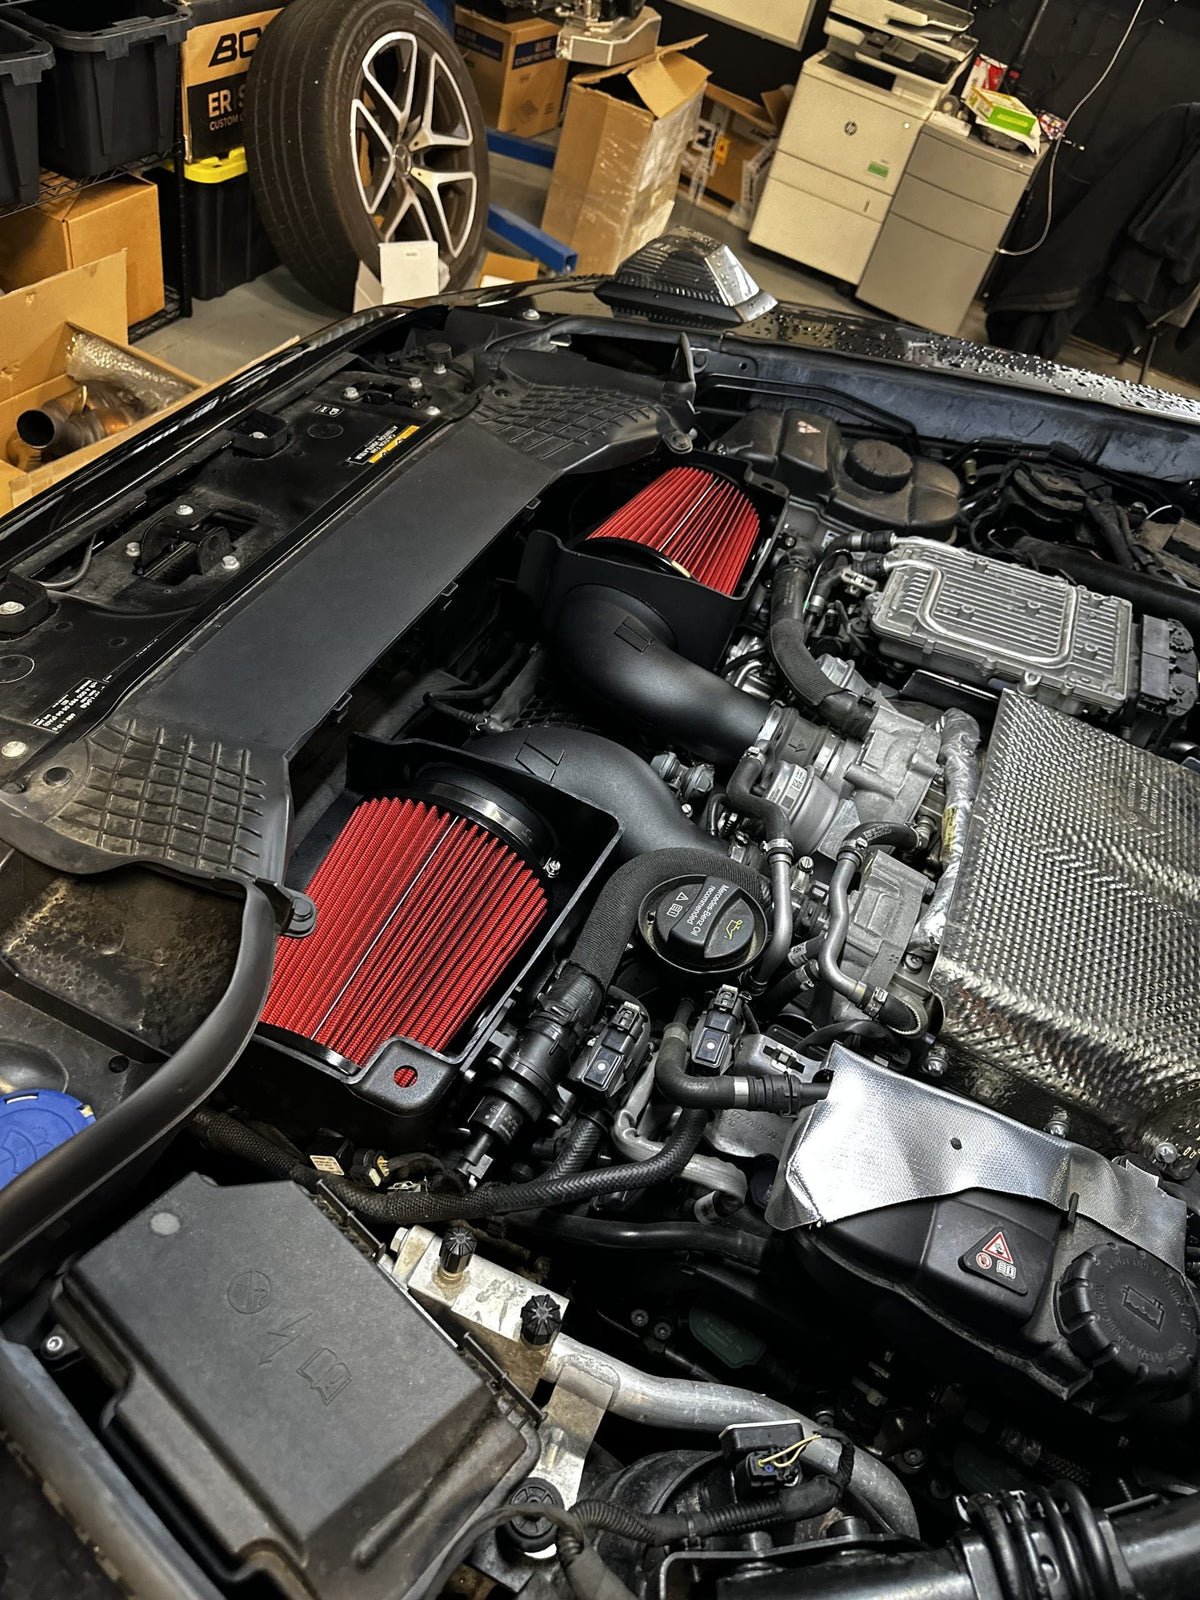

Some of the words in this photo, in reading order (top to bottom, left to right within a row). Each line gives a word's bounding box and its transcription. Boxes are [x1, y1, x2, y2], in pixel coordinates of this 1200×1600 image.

[207, 88, 232, 118] ER
[209, 113, 239, 131] CUSTOM
[686, 885, 716, 925] recommended
[696, 884, 729, 926] Mercedes-Benz
[691, 926, 701, 937] Oil
